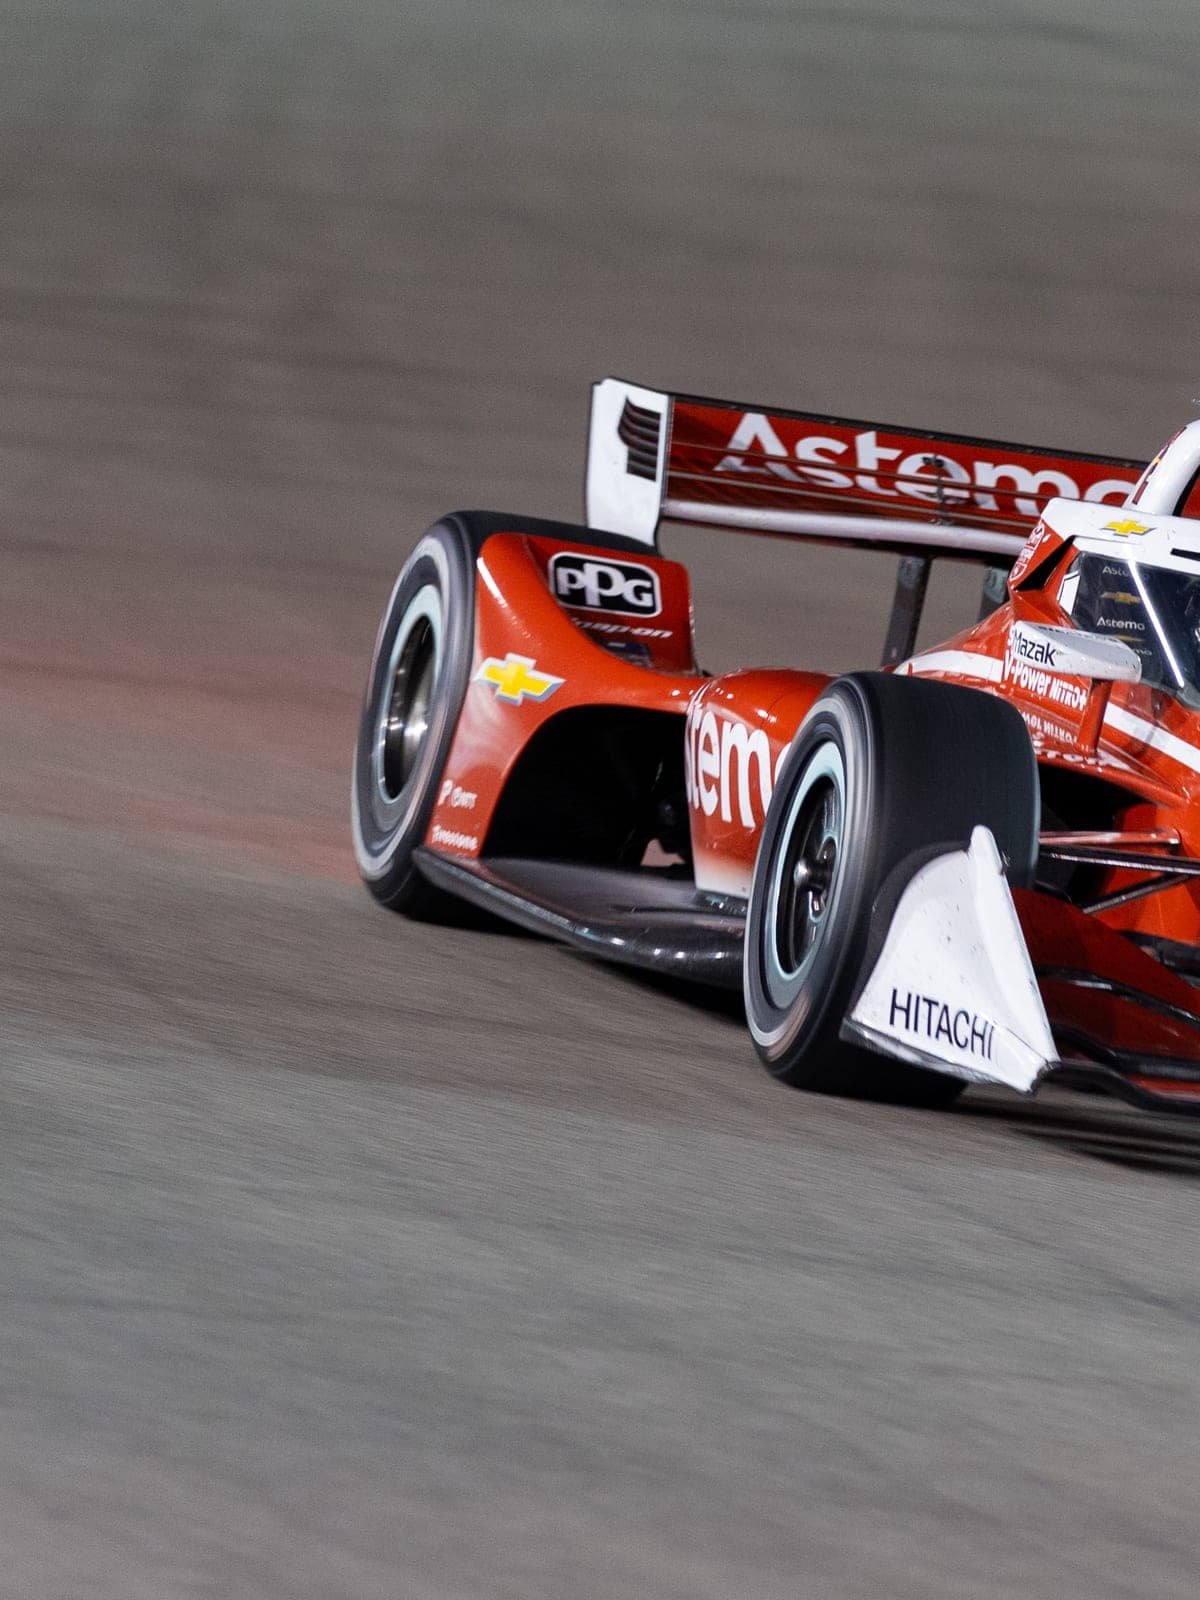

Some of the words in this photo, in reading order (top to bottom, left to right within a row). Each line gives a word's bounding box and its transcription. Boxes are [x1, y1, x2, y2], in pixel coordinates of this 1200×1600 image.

[556, 562, 655, 607] PPG
[1097, 616, 1146, 631] Astemo
[1013, 632, 1057, 667] Mazak
[889, 988, 995, 1060] HITACHI
